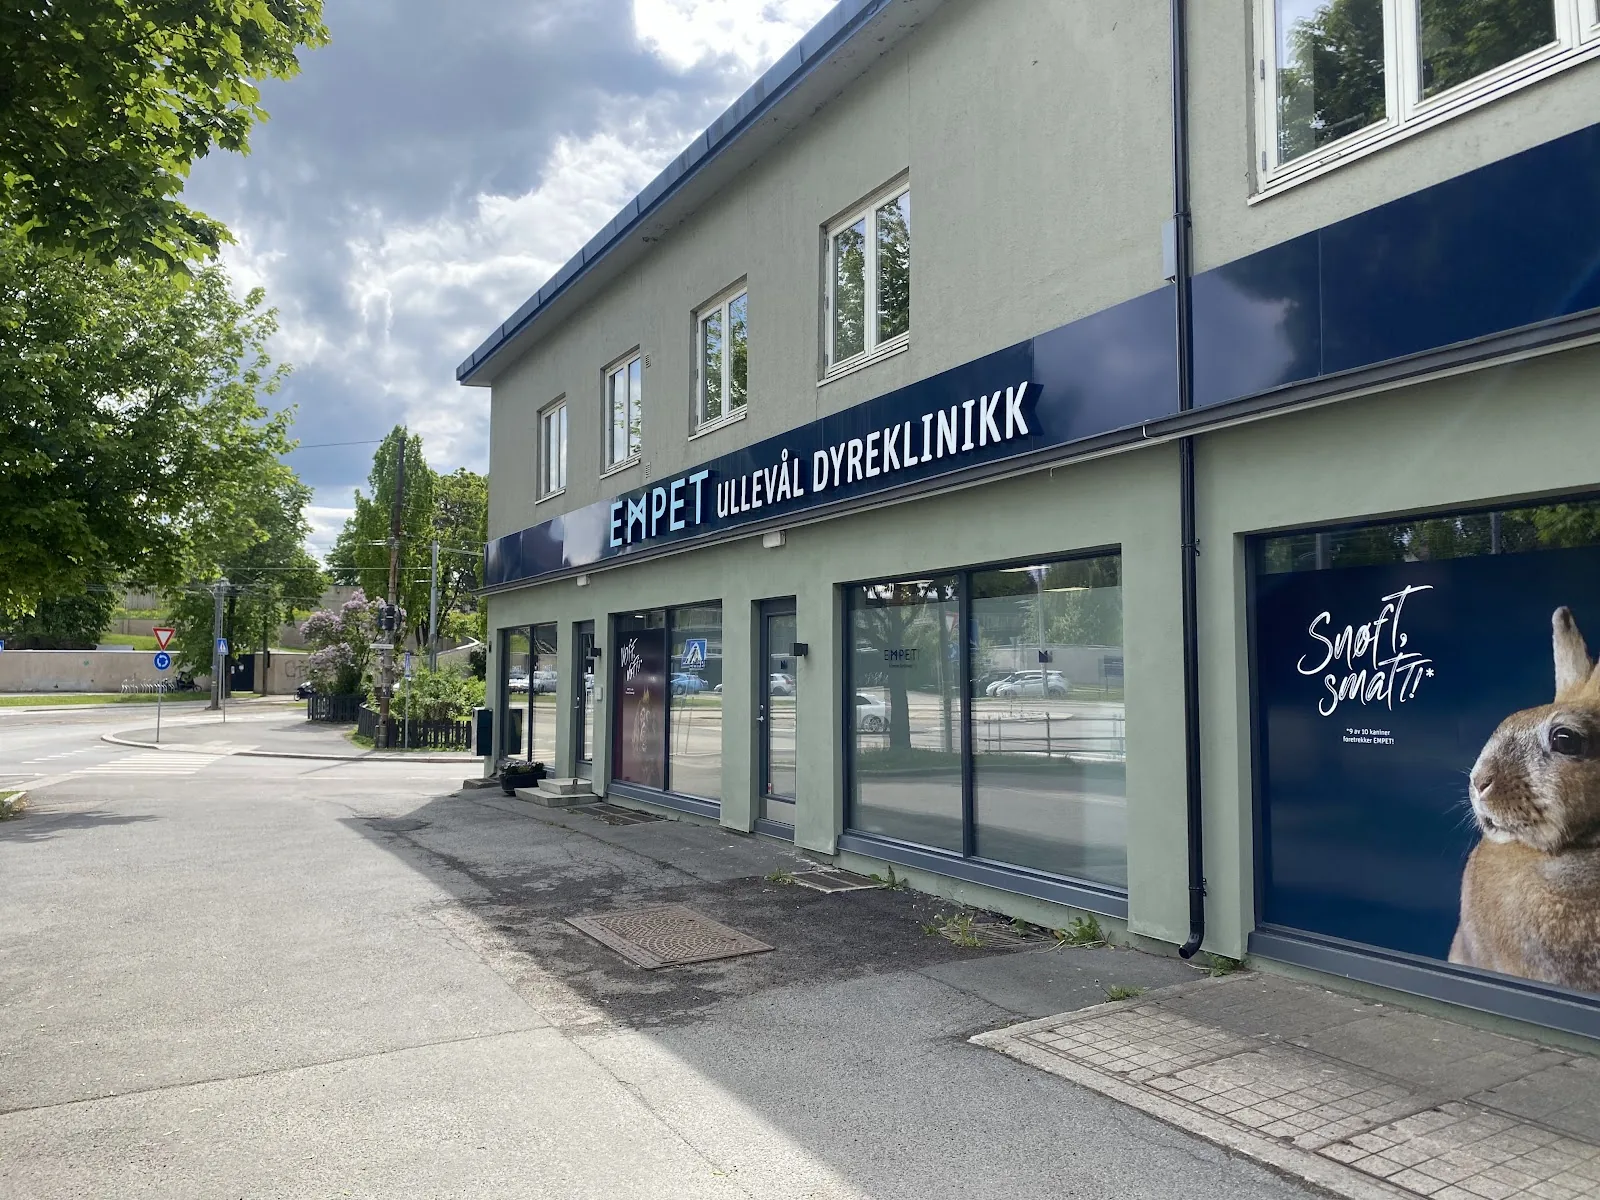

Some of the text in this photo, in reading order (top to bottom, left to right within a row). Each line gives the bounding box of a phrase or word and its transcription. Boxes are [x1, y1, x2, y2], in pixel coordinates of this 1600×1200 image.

[609, 381, 1029, 548] EMPET ULLEVÅL DYREKLINIKK
[884, 649, 917, 660] EMPET
